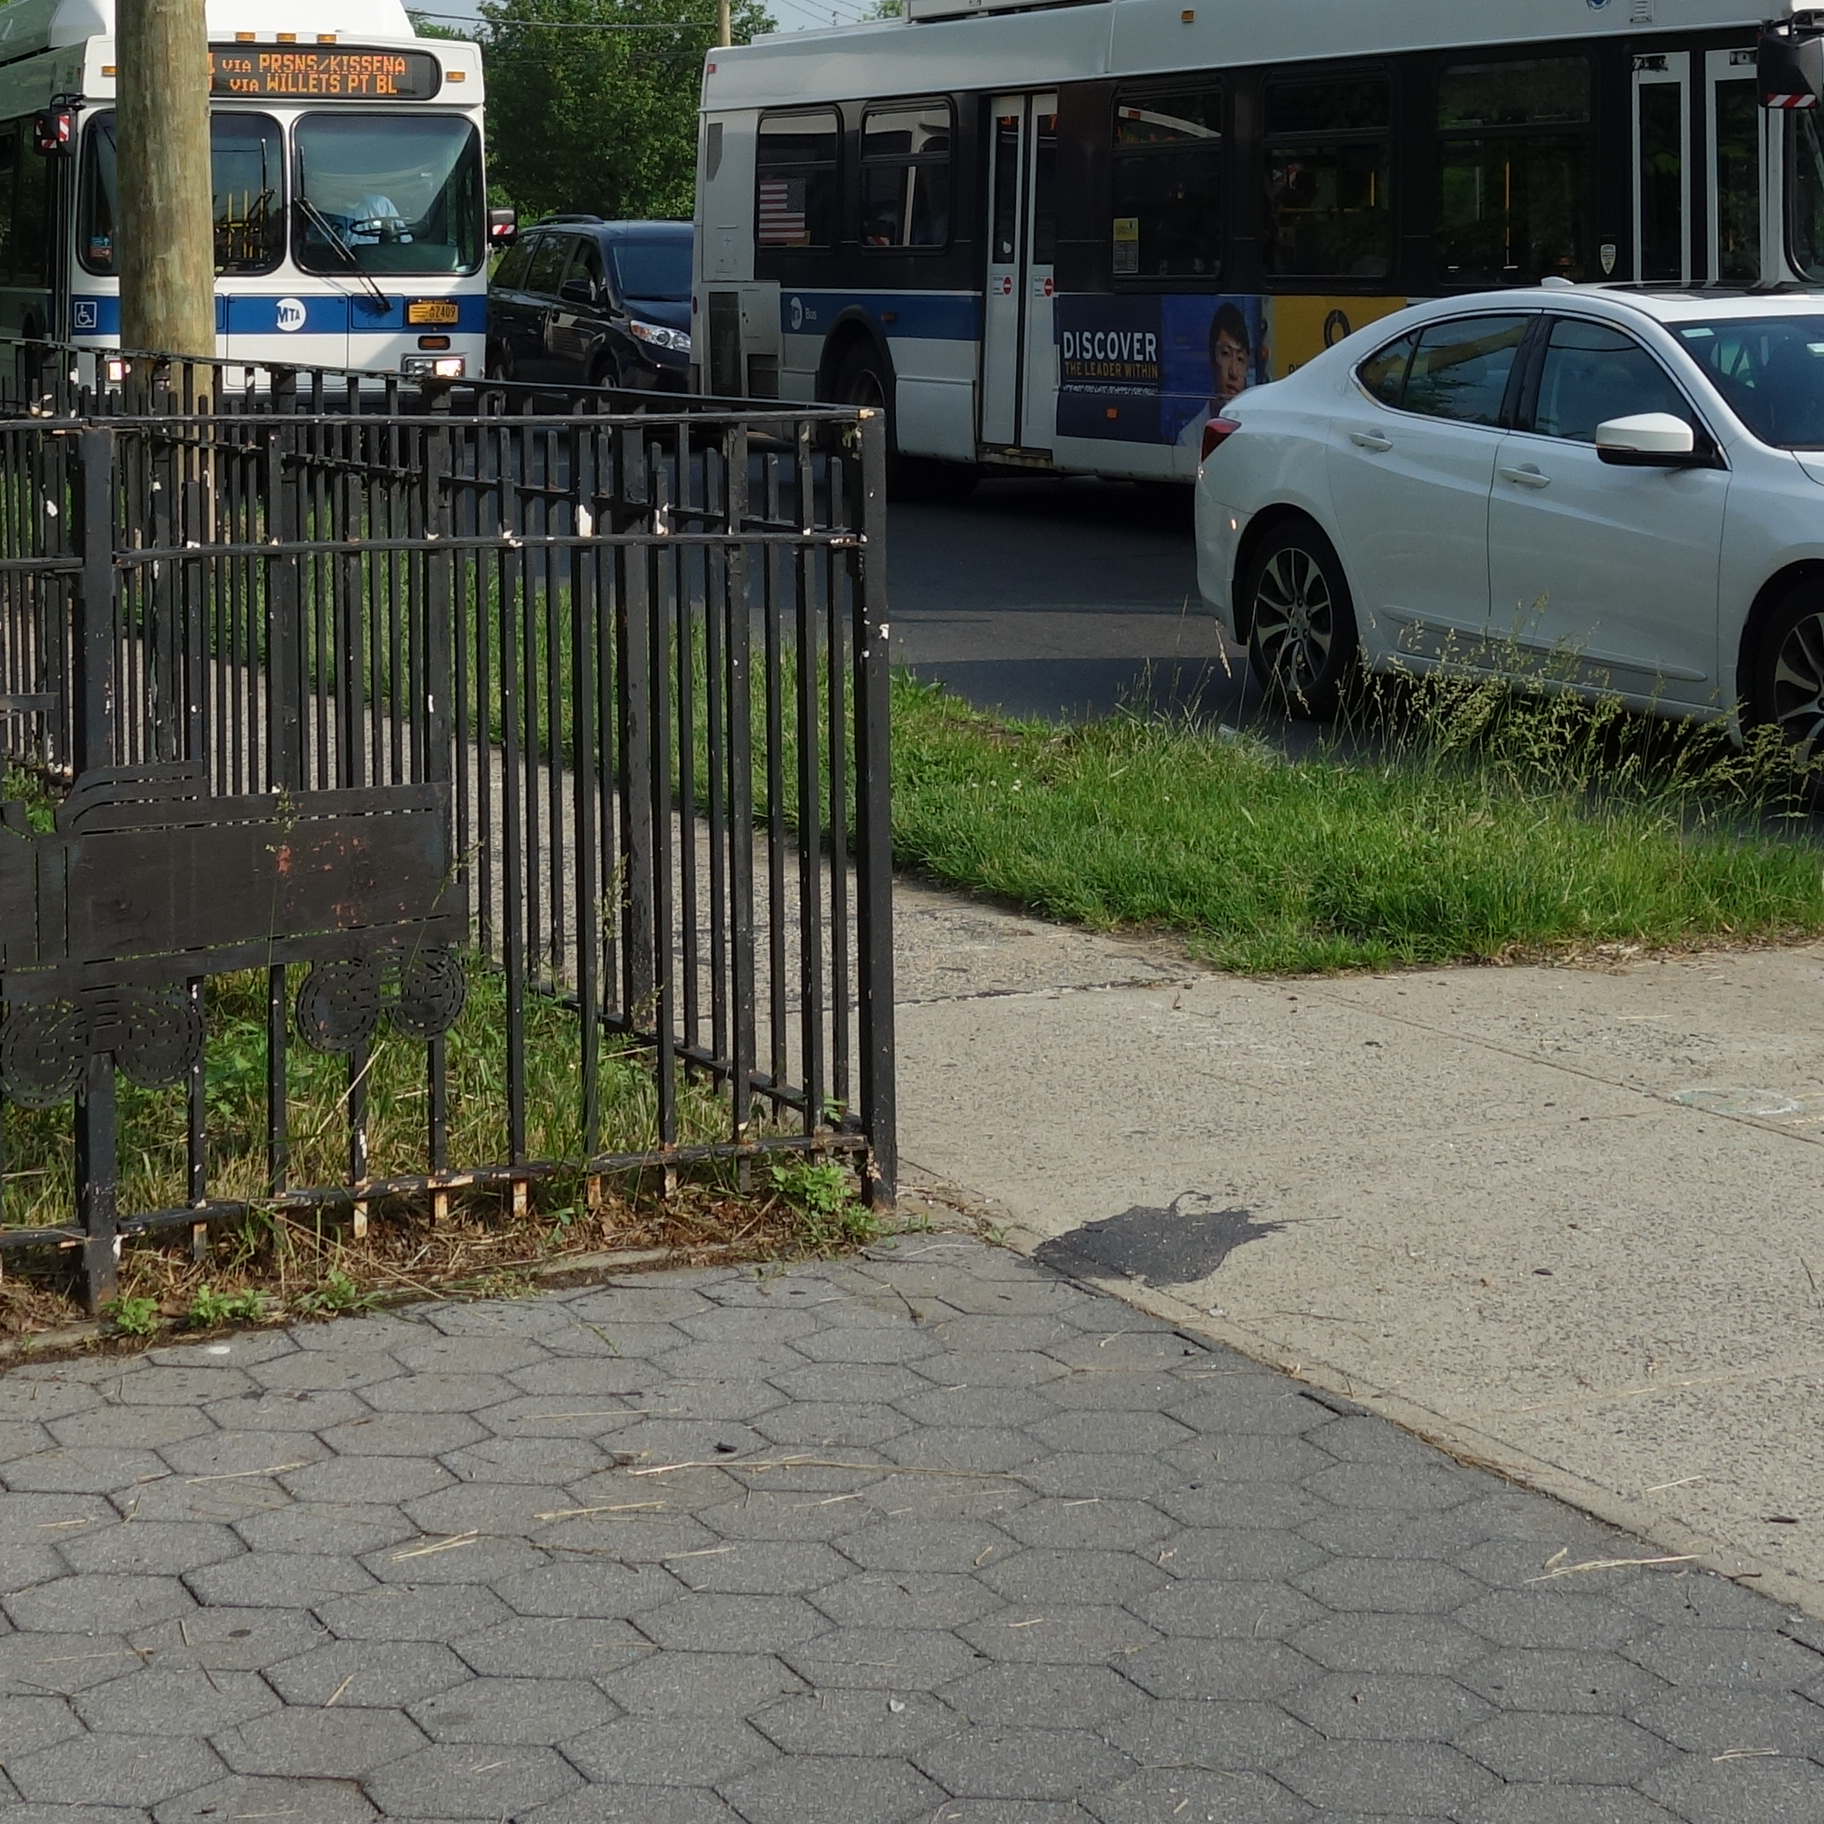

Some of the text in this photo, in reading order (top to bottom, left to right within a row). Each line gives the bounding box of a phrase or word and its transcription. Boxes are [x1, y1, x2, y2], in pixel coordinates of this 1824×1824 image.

[258, 54, 406, 75] PRSNS/KISSENA
[266, 74, 340, 93] WILLETS
[347, 74, 369, 94] PT
[375, 75, 398, 95] BL
[276, 306, 301, 324] MTA
[1063, 331, 1157, 362] DISCOVER
[1064, 361, 1158, 379] THE LEADER WITHIN
